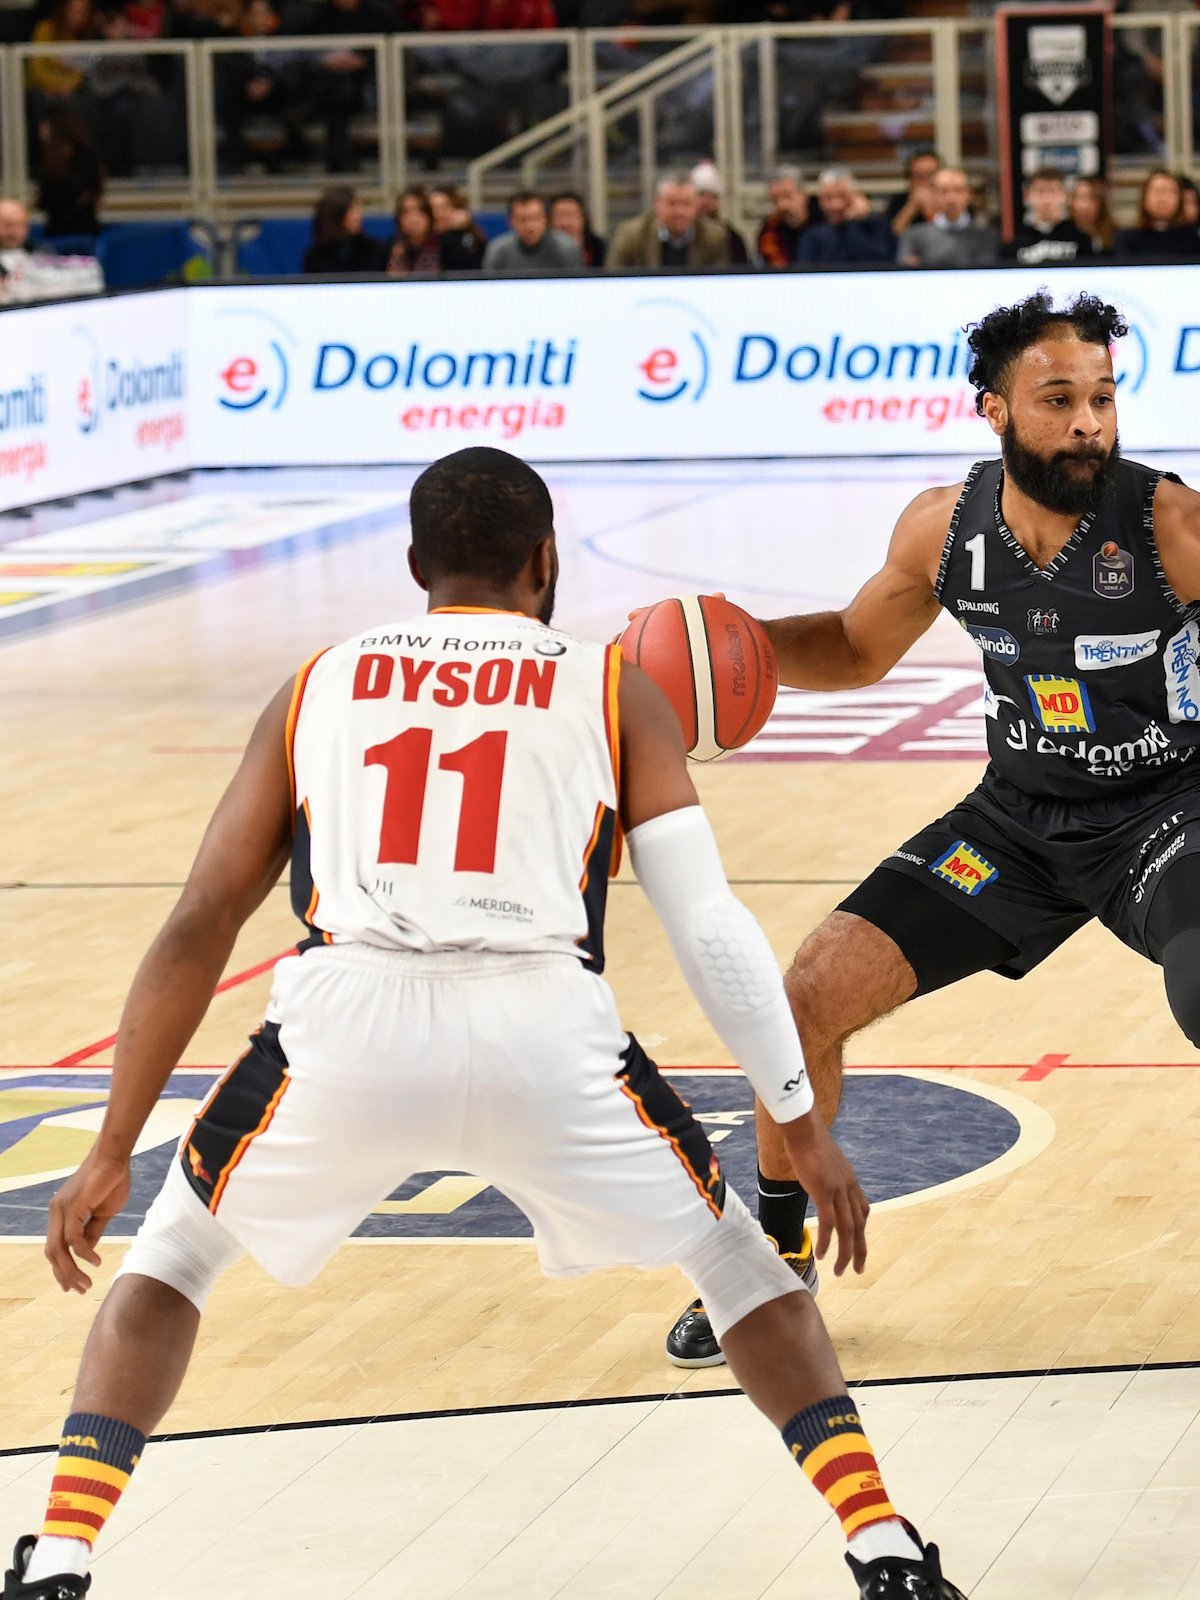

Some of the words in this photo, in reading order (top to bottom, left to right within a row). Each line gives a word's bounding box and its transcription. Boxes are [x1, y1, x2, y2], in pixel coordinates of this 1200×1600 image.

[312, 338, 578, 392] Dolomiti
[734, 328, 972, 383] Dolomi
[400, 400, 566, 439] energia
[964, 533, 985, 592] 1
[1098, 571, 1129, 585] LBA
[957, 599, 999, 615] SPALDING
[360, 634, 432, 649] BMW
[442, 638, 523, 651] Roma
[974, 633, 1016, 655] elinda
[1080, 638, 1156, 662] TRENTINO
[352, 653, 557, 710] DYSON
[1171, 630, 1200, 721] TRENINO
[1038, 692, 1079, 714] MD
[364, 727, 509, 875] 11
[470, 897, 534, 916] MERIDIEN
[59, 1435, 99, 1450] OMA
